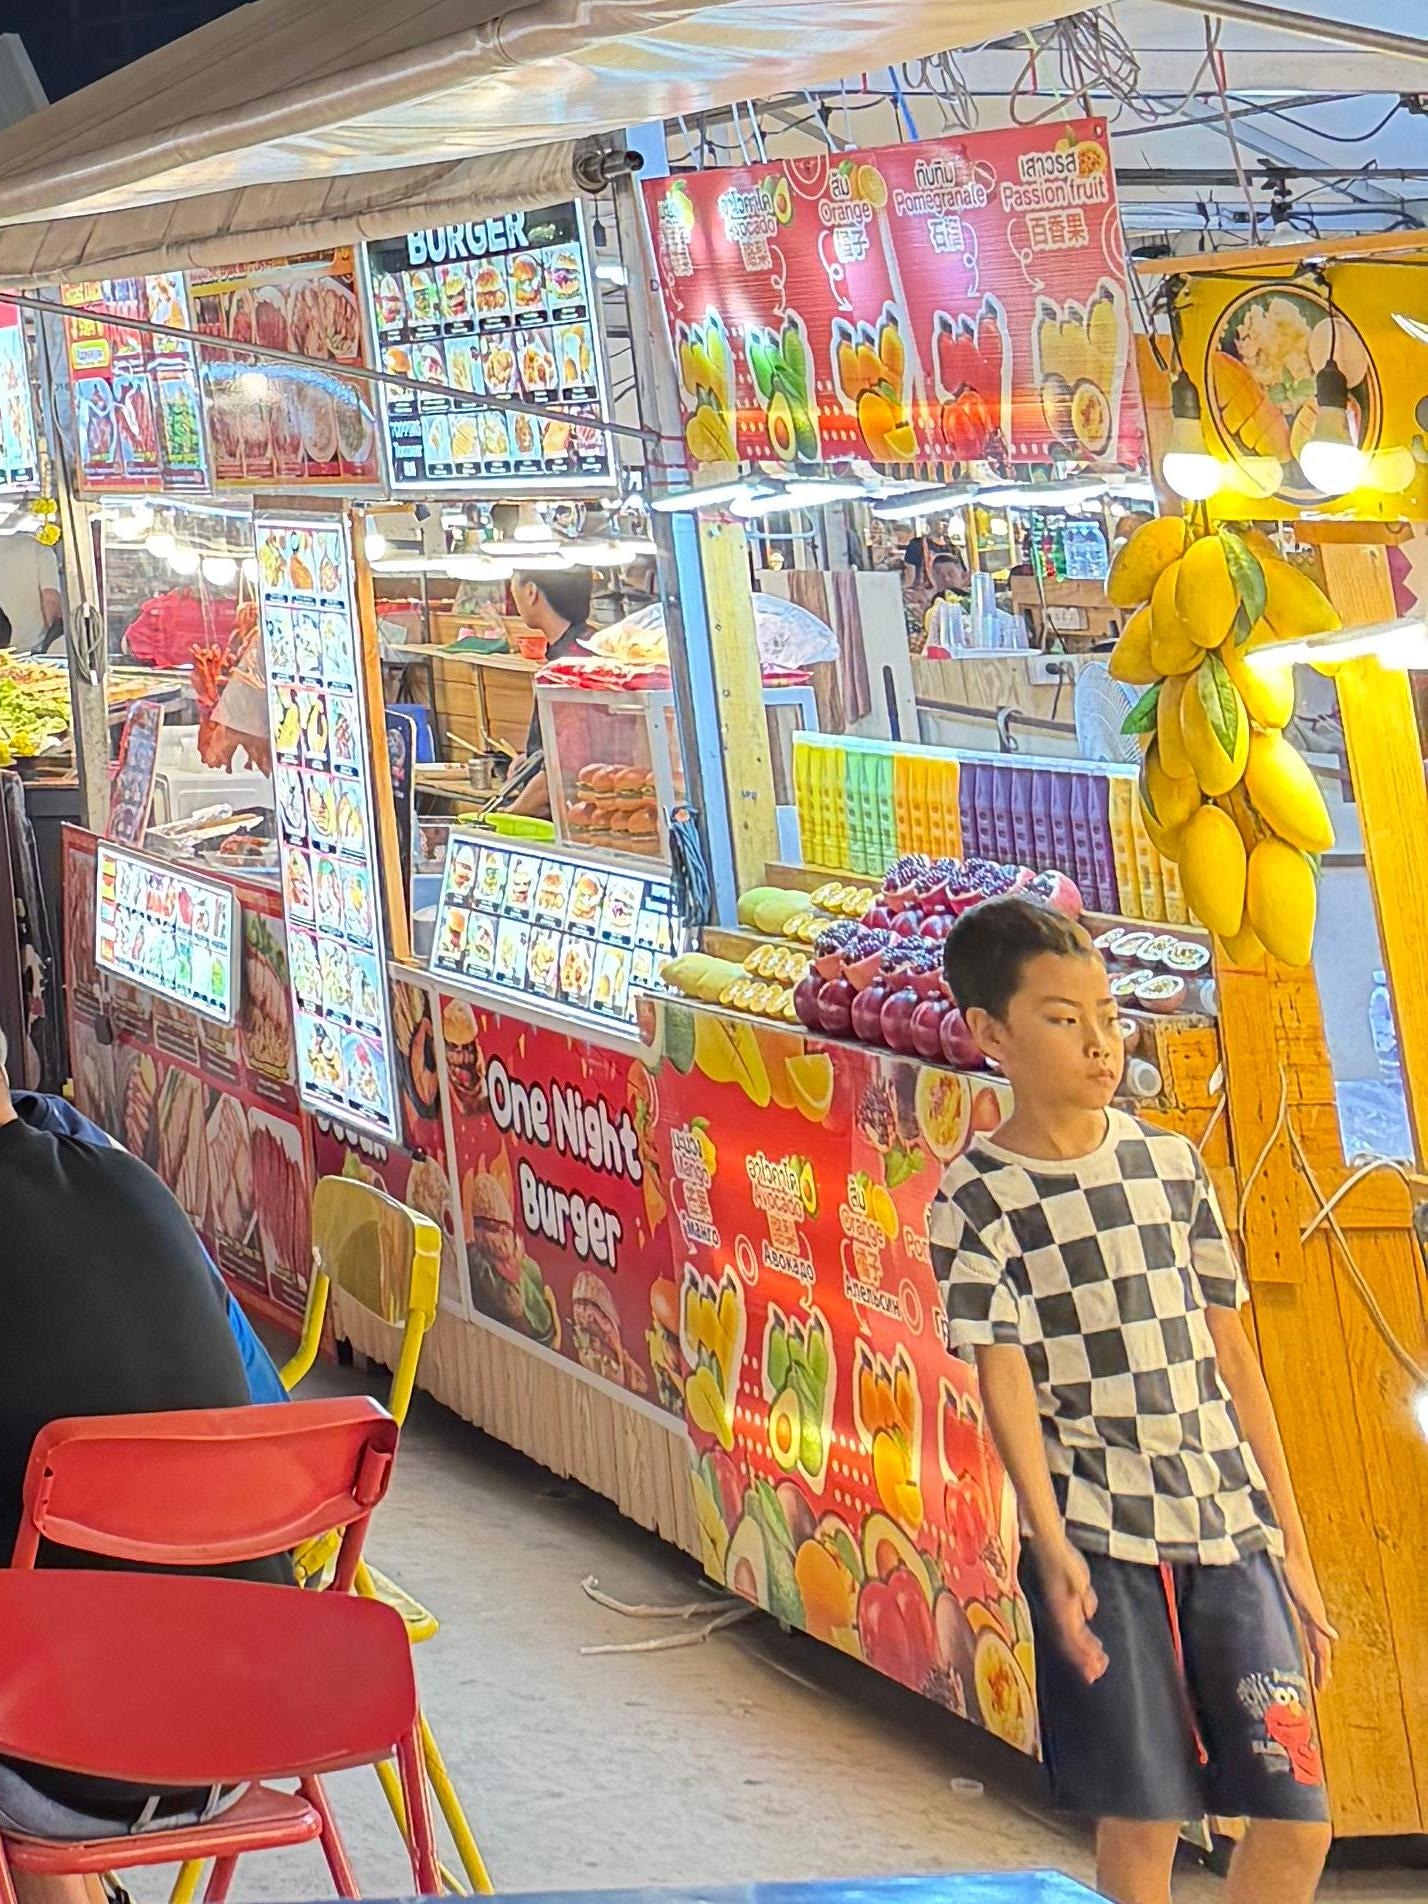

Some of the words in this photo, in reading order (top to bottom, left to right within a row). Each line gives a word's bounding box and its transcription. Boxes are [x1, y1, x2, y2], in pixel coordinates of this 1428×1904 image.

[820, 201, 871, 222] Orange
[1003, 182, 1066, 207] Passion
[1069, 177, 1107, 204] fruit
[407, 212, 529, 265] BURGER
[488, 1059, 550, 1143] One
[552, 1083, 642, 1181] Night
[519, 1162, 621, 1269] Burger
